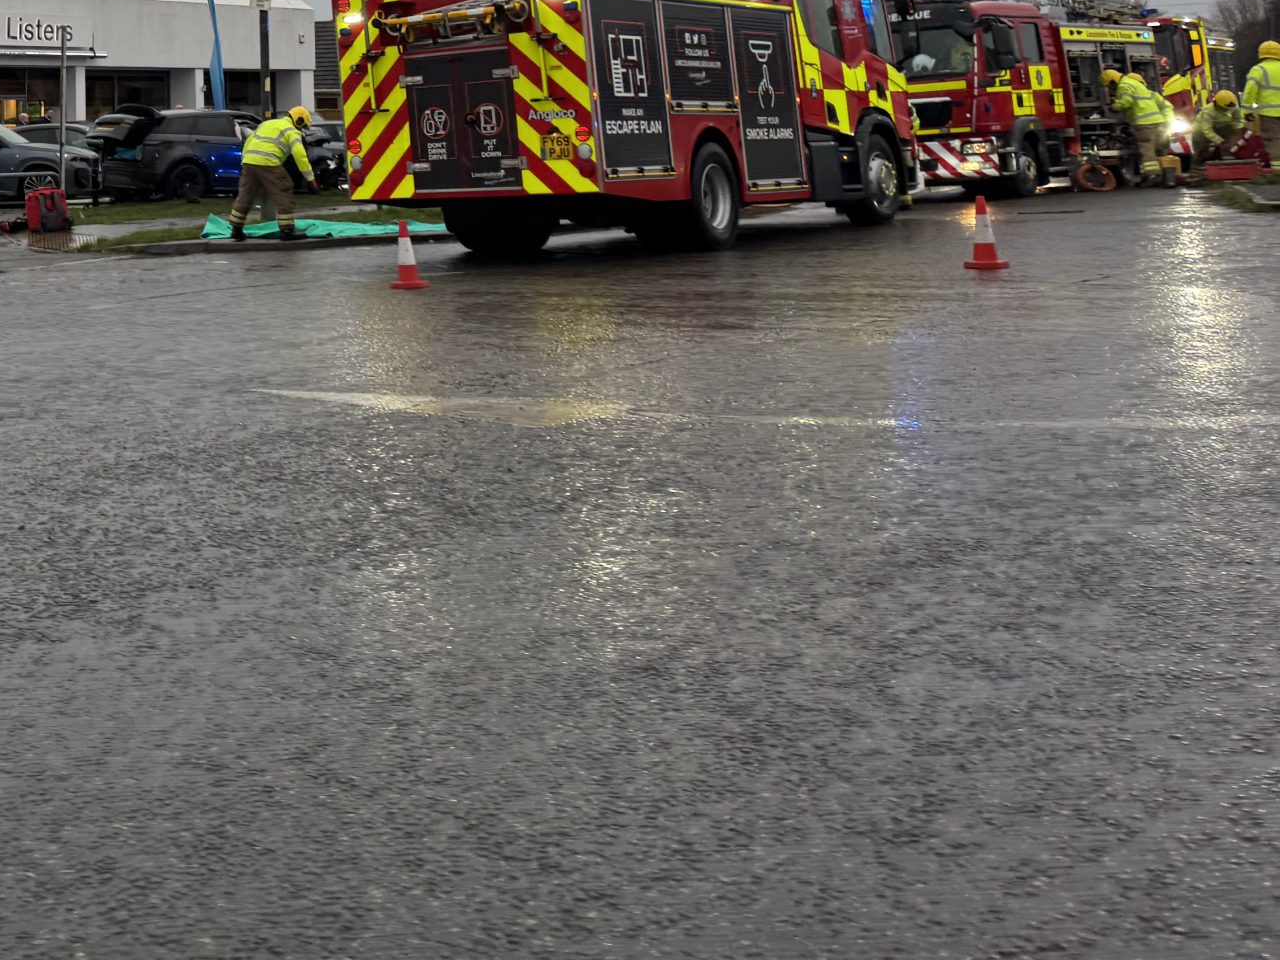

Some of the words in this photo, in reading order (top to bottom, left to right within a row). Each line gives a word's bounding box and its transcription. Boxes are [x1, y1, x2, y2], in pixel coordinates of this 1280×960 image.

[6, 16, 73, 42] Listers
[528, 109, 576, 122] Angloco
[605, 120, 640, 135] ESCAPE
[640, 120, 663, 135] PLAN
[746, 128, 769, 140] SMOKE
[769, 128, 794, 140] ALARMS
[543, 136, 570, 147] FY69
[549, 147, 570, 159] PJU
